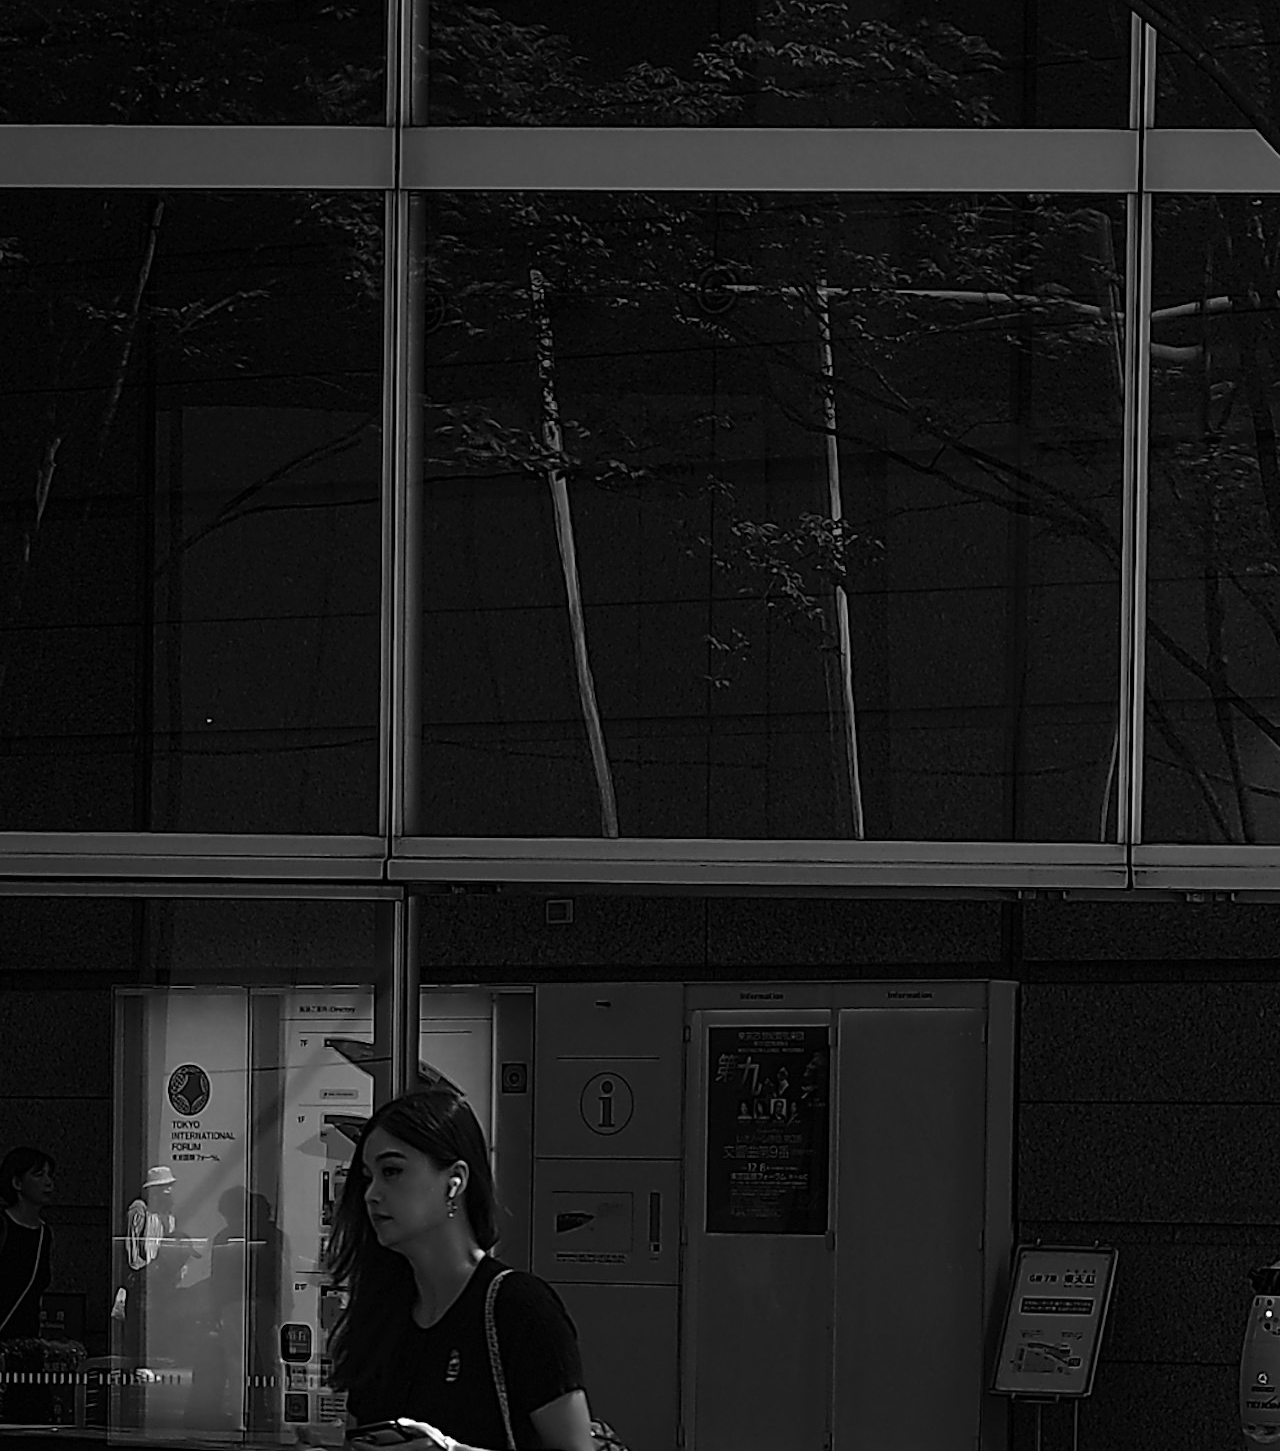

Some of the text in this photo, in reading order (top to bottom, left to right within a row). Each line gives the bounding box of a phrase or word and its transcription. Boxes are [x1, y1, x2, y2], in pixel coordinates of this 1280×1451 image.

[172, 1120, 201, 1129] TOKYO
[171, 1131, 236, 1140] INTERNATIONAL
[171, 1142, 202, 1151] FORUM
